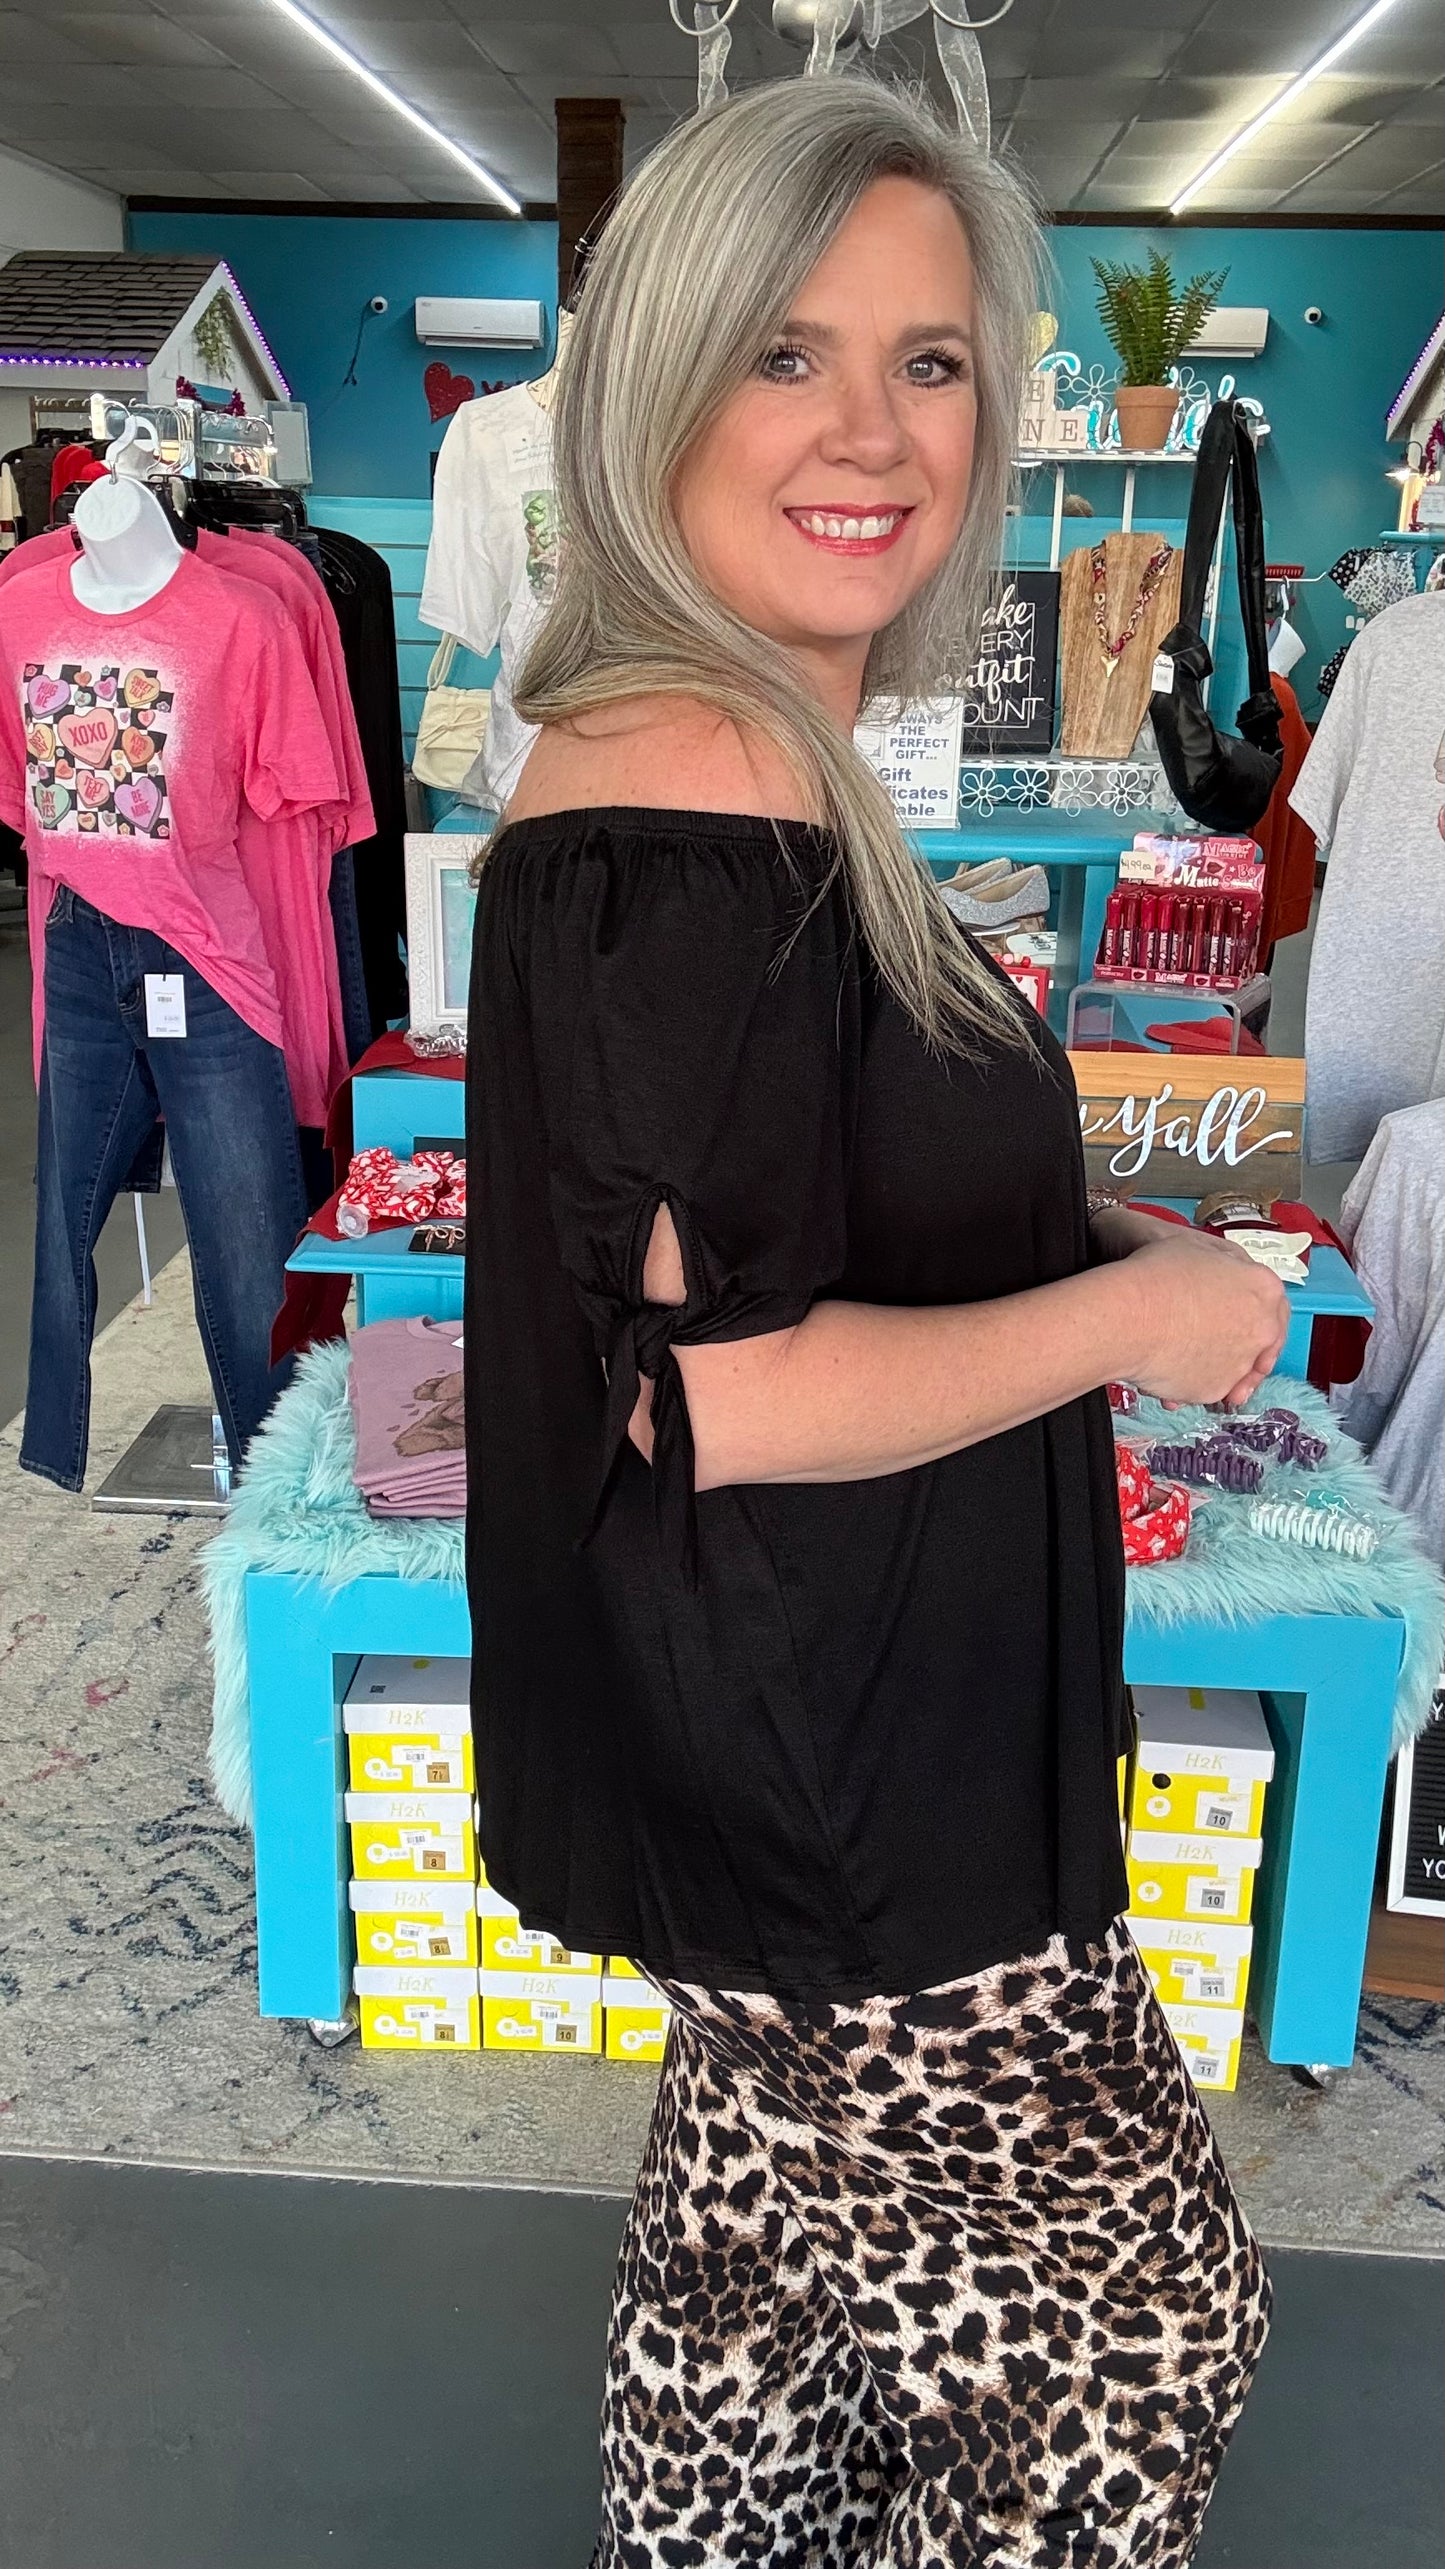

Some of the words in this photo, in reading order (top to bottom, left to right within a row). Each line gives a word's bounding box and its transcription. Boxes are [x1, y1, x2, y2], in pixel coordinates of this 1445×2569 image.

[1030, 380, 1045, 402] E
[981, 584, 1033, 628] ake
[963, 698, 1045, 724] OUNT
[68, 721, 108, 747] XOXO
[900, 726, 926, 736] THE
[889, 738, 949, 748] PERFECT
[879, 767, 911, 781] Gift
[40, 790, 55, 804] SAY
[888, 786, 949, 800] icates
[42, 805, 56, 818] YES
[896, 803, 935, 816] able
[388, 1710, 426, 1726] H2K
[1185, 1752, 1227, 1770] H2K
[391, 1802, 428, 1818] H2K
[1213, 1815, 1226, 1826] 10
[1176, 1843, 1216, 1860] H2K
[430, 1858, 437, 1867] 8
[394, 1891, 432, 1907] H2K
[1207, 1896, 1220, 1906] 10
[1167, 1929, 1207, 1946] H2K
[556, 1953, 563, 1962] 9
[398, 1977, 436, 1992] H2K
[522, 1978, 560, 1994] H2K
[1207, 1986, 1218, 1995] 11
[1169, 2011, 1198, 2027] 2K
[560, 2031, 571, 2040] 10
[1200, 2065, 1212, 2075] 11
